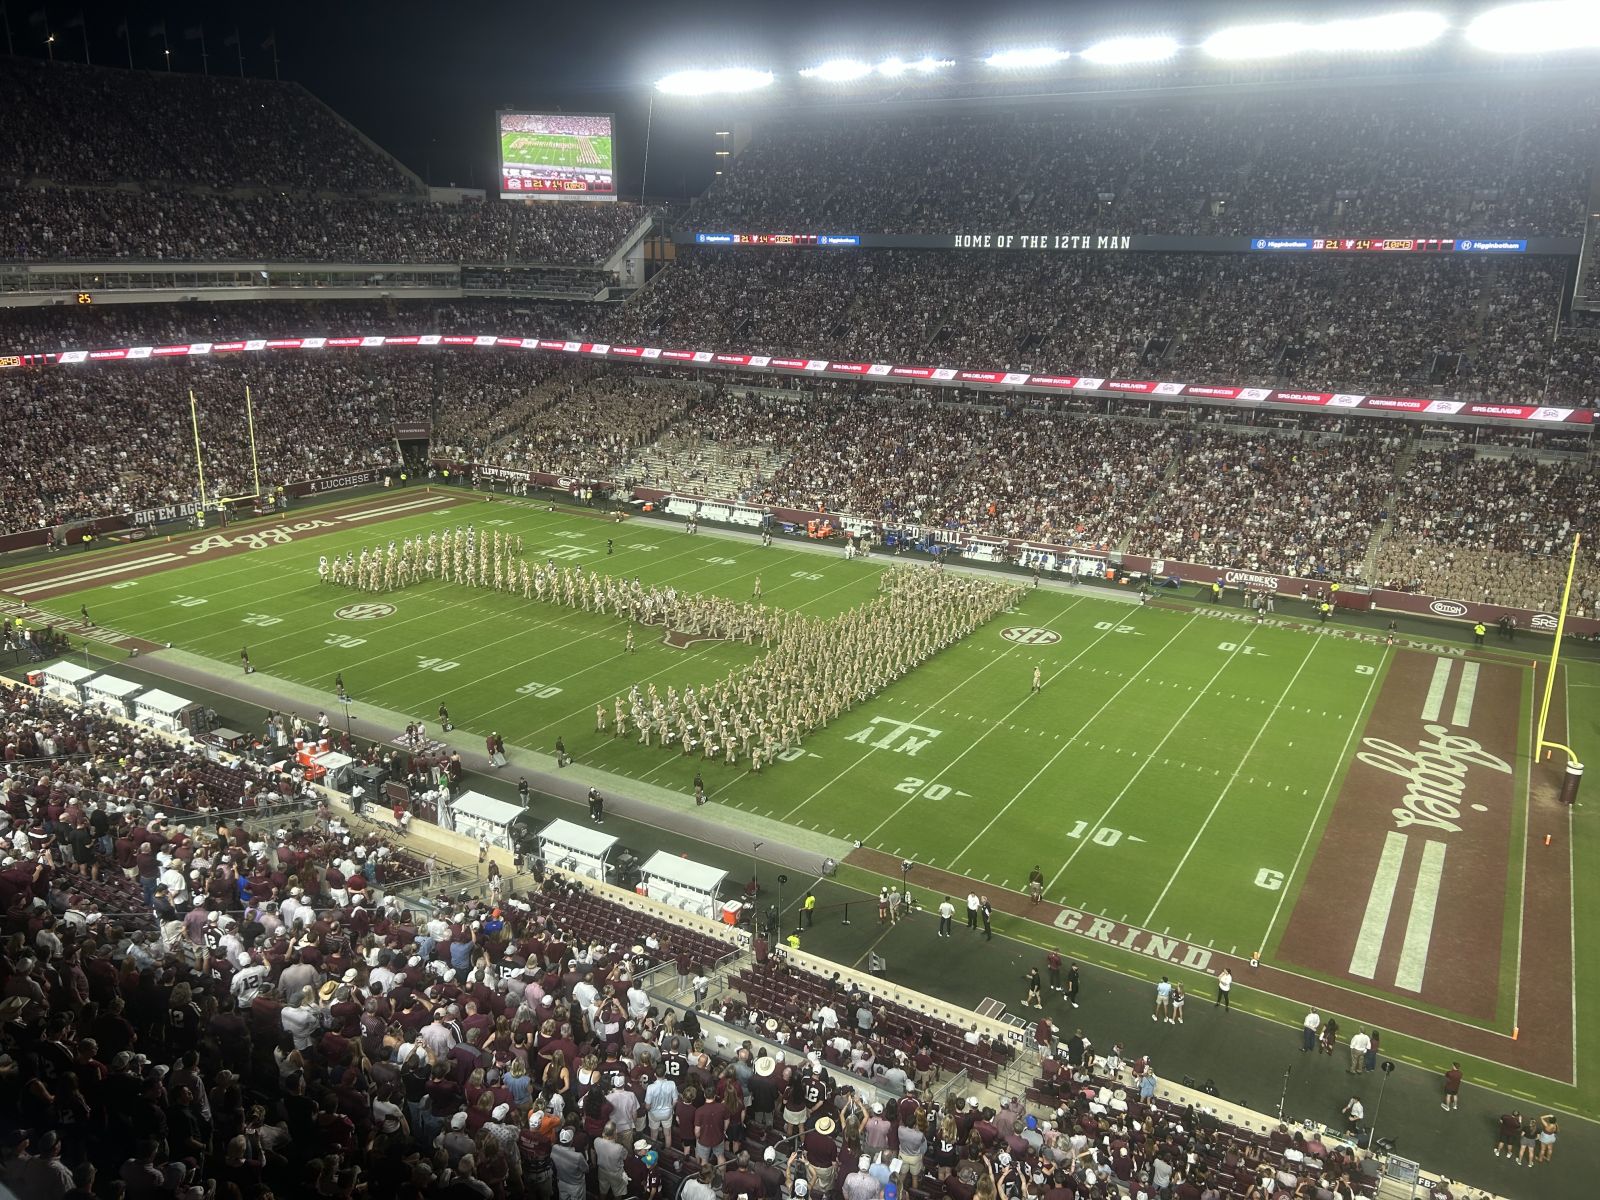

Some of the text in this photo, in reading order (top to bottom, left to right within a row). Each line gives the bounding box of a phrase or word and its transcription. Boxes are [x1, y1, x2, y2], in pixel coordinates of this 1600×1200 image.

[955, 235, 1131, 249] HOME OF THE 12TH MAN
[1326, 241, 1339, 249] 21
[1355, 241, 1370, 249] 14
[1385, 241, 1411, 249] 10:43
[1473, 241, 1520, 250] Higginbotham
[78, 294, 91, 304] 25
[1486, 407, 1522, 415] DELIVERS
[320, 473, 370, 490] LUCCHESE
[135, 511, 155, 524] GIG
[187, 517, 342, 555] Aggies
[1225, 571, 1280, 589] CAVENDER'S
[169, 595, 209, 607] 10
[1434, 601, 1462, 615] COTTON
[338, 604, 393, 620] SEC
[241, 614, 284, 627] 20
[1093, 621, 1136, 634] 20
[1531, 617, 1558, 628] SRS
[80, 628, 131, 643] MAN
[1002, 627, 1059, 644] SEC
[1192, 607, 1256, 621] HOME
[1262, 618, 1290, 627] OF
[1300, 624, 1345, 638] THE
[1408, 640, 1465, 656] MAN
[324, 635, 368, 648] 30
[1217, 641, 1257, 656] 10
[417, 657, 461, 672] 40
[1354, 664, 1376, 676] G
[515, 681, 564, 699] 50
[1356, 724, 1513, 832] Aggies
[893, 776, 953, 801] 20
[1065, 820, 1123, 847] 10
[853, 840, 861, 849] 20
[1253, 868, 1285, 891] G
[204, 934, 217, 950] 12
[1053, 908, 1216, 974] G.R.I.N.D.
[1250, 959, 1258, 968] G
[499, 966, 512, 980] 12
[242, 974, 259, 990] 12
[169, 1009, 184, 1027] 12
[1008, 1031, 1023, 1041] FB4
[664, 1060, 680, 1076] 12
[805, 1085, 819, 1103] 12
